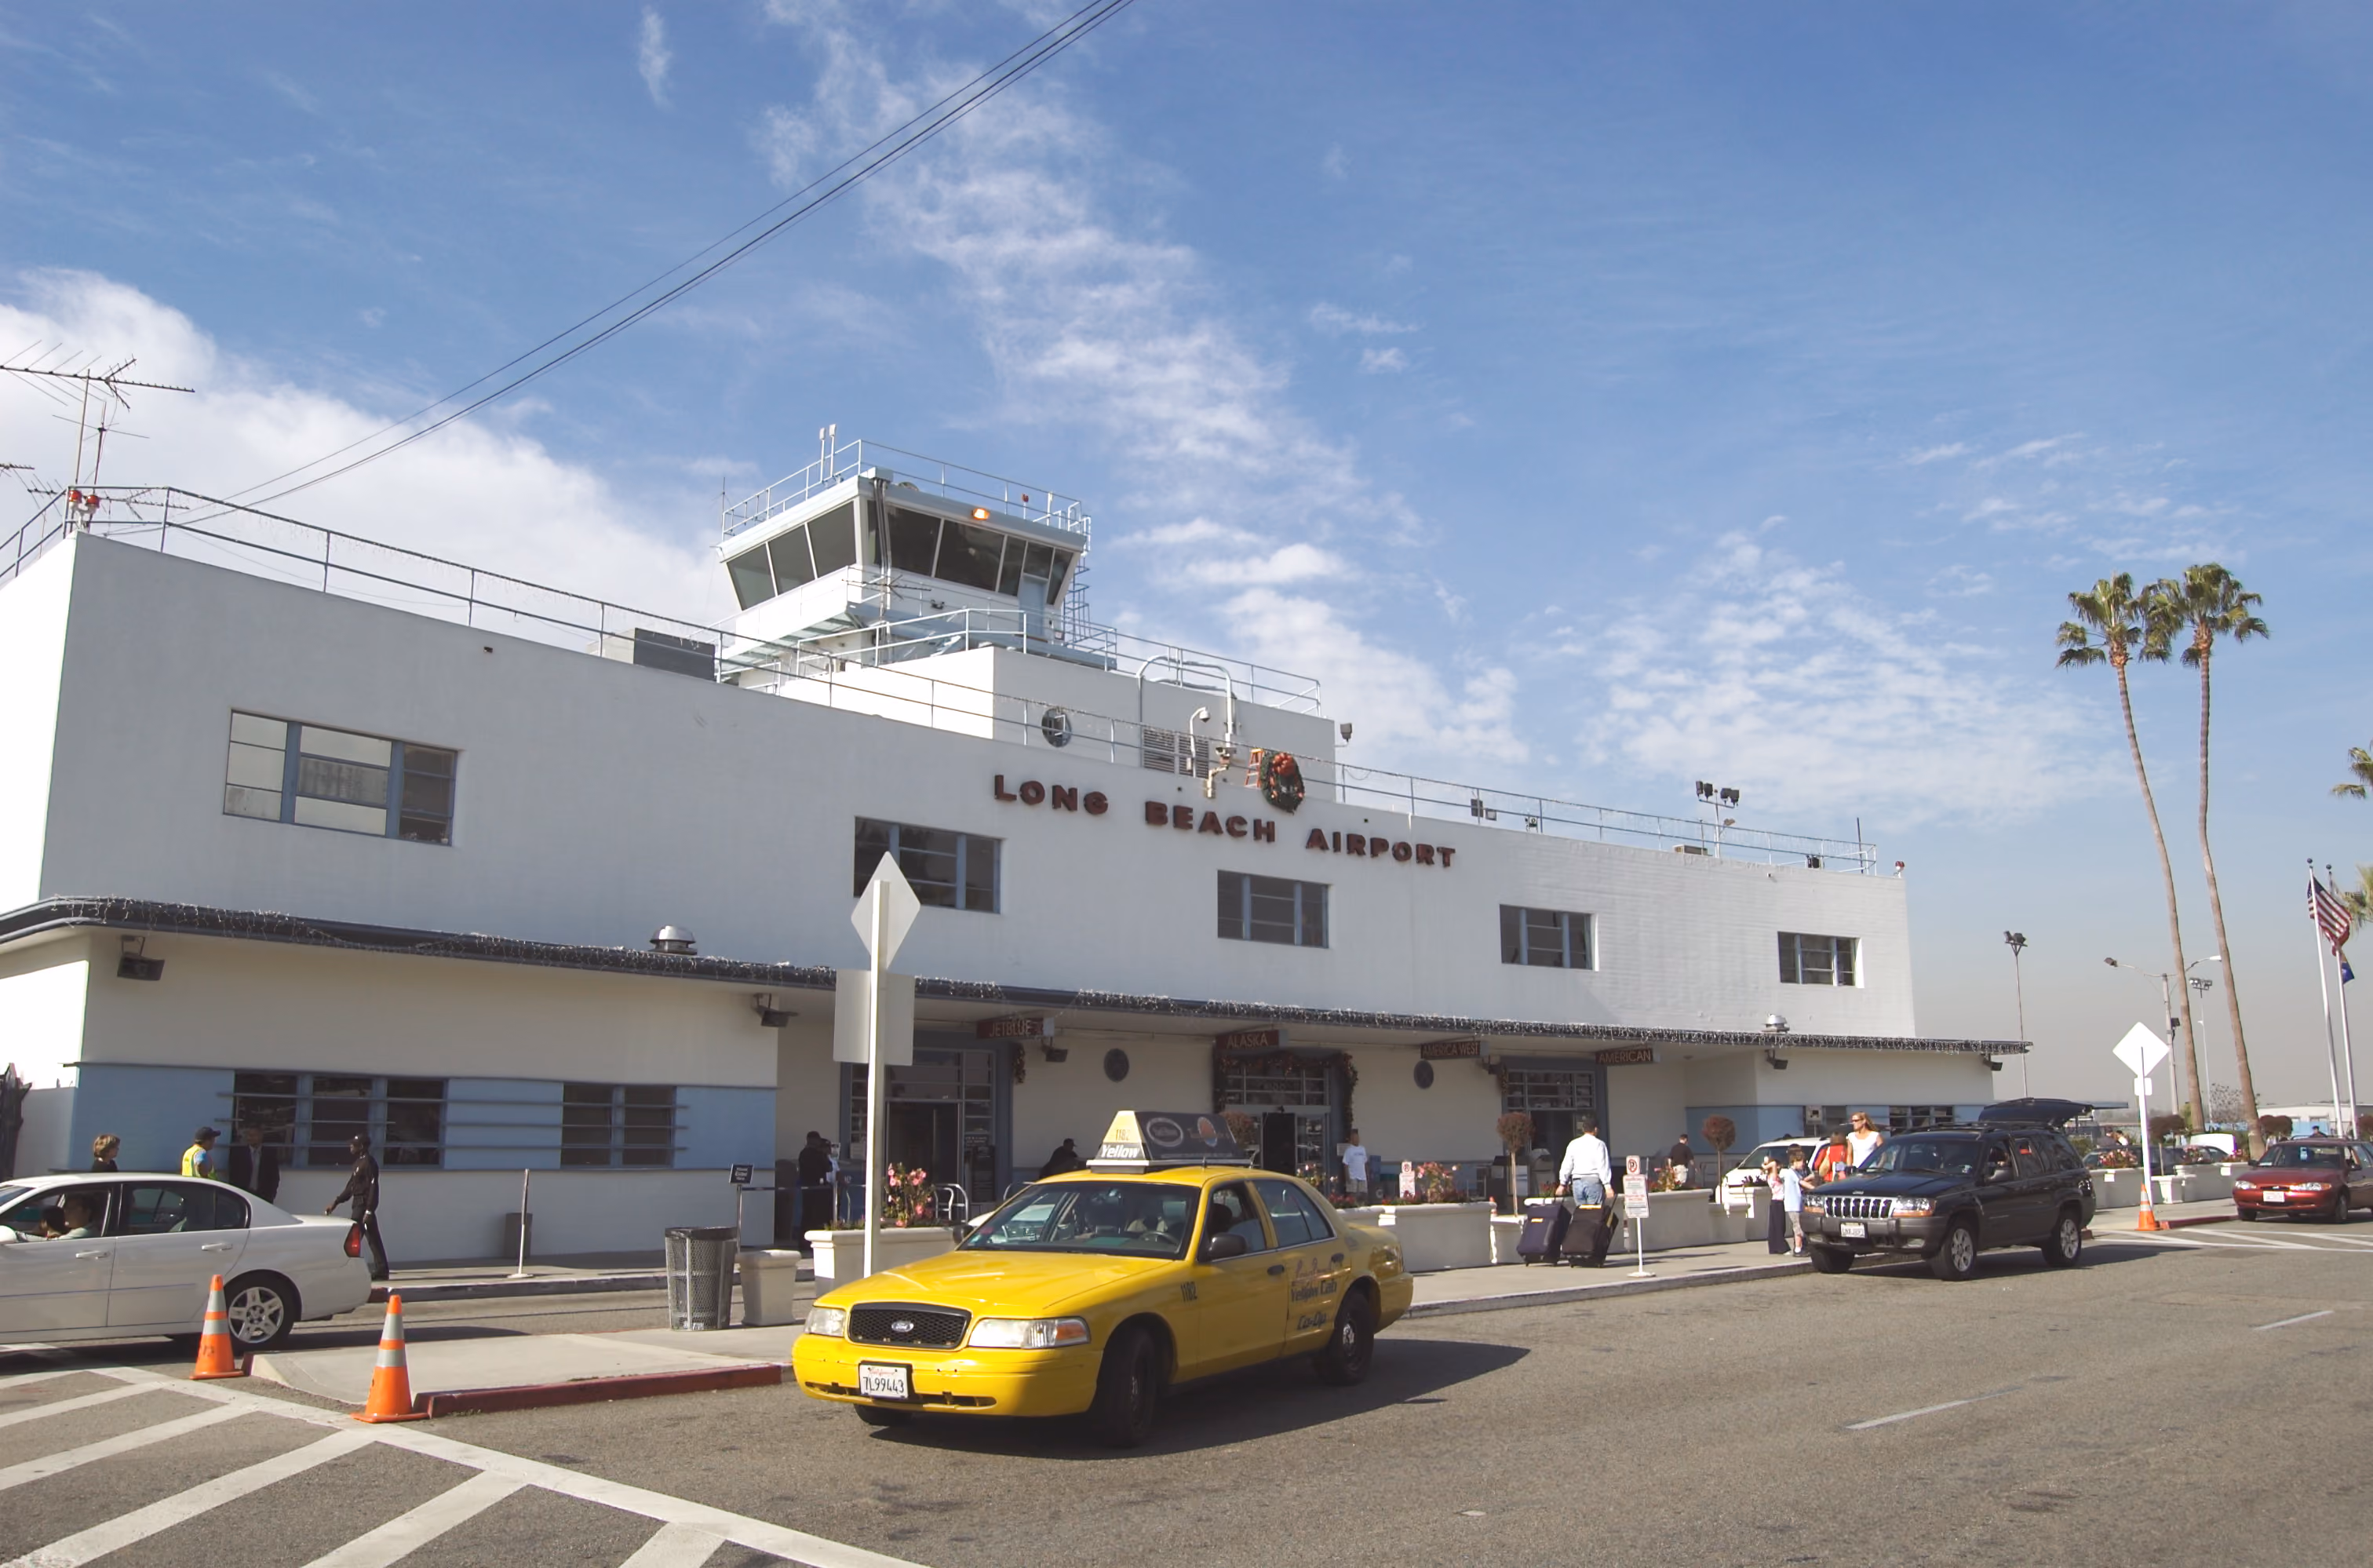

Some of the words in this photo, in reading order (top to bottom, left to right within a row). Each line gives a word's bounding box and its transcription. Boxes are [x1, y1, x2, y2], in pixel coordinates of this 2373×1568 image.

[994, 775, 1109, 815] LONG
[1145, 800, 1276, 843] BEACH
[1305, 828, 1456, 868] AIRPORT
[989, 1019, 1031, 1037] JETBLUE
[1227, 1032, 1269, 1049] ALASKA
[1421, 1041, 1458, 1058] AMERICA
[1459, 1041, 1479, 1056] WEST
[1598, 1049, 1652, 1064] AMERICAN
[1115, 1129, 1131, 1142] 1182
[1100, 1143, 1140, 1159] Yellow
[1180, 1281, 1198, 1303] 1182
[1320, 1279, 1338, 1296] Cab
[862, 1377, 905, 1394] 7L99443
